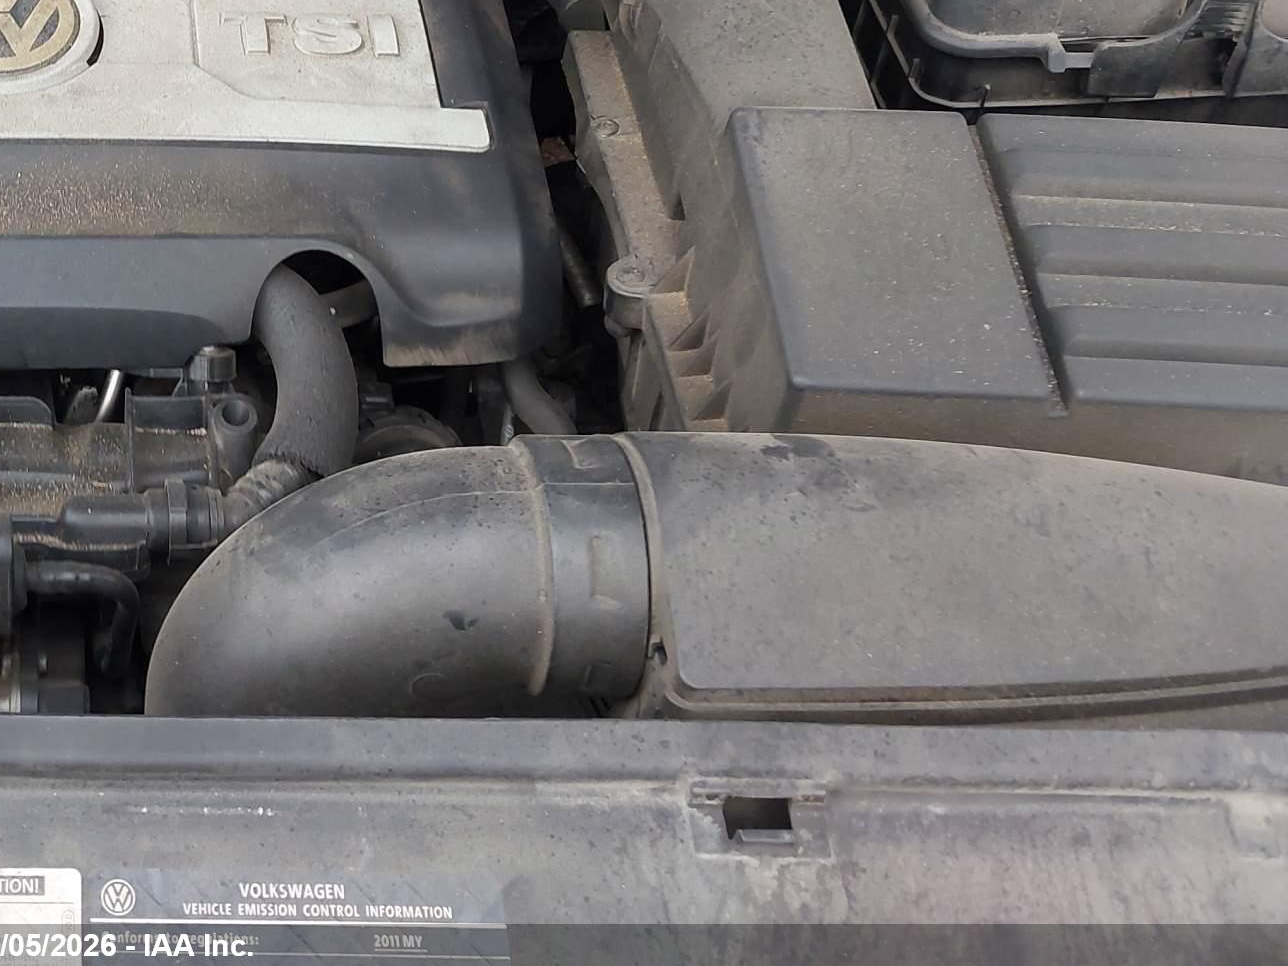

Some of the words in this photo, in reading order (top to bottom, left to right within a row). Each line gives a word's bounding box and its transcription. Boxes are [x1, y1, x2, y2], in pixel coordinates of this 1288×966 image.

[218, 10, 402, 58] TSI
[238, 882, 345, 900] VOLKSWAGEN
[182, 902, 232, 916] VEHICLE
[238, 903, 297, 917] EMISSION
[303, 904, 361, 918] CONTROL
[365, 905, 453, 920] INFORMATION
[373, 934, 400, 948] 2011
[402, 935, 423, 949] MY
